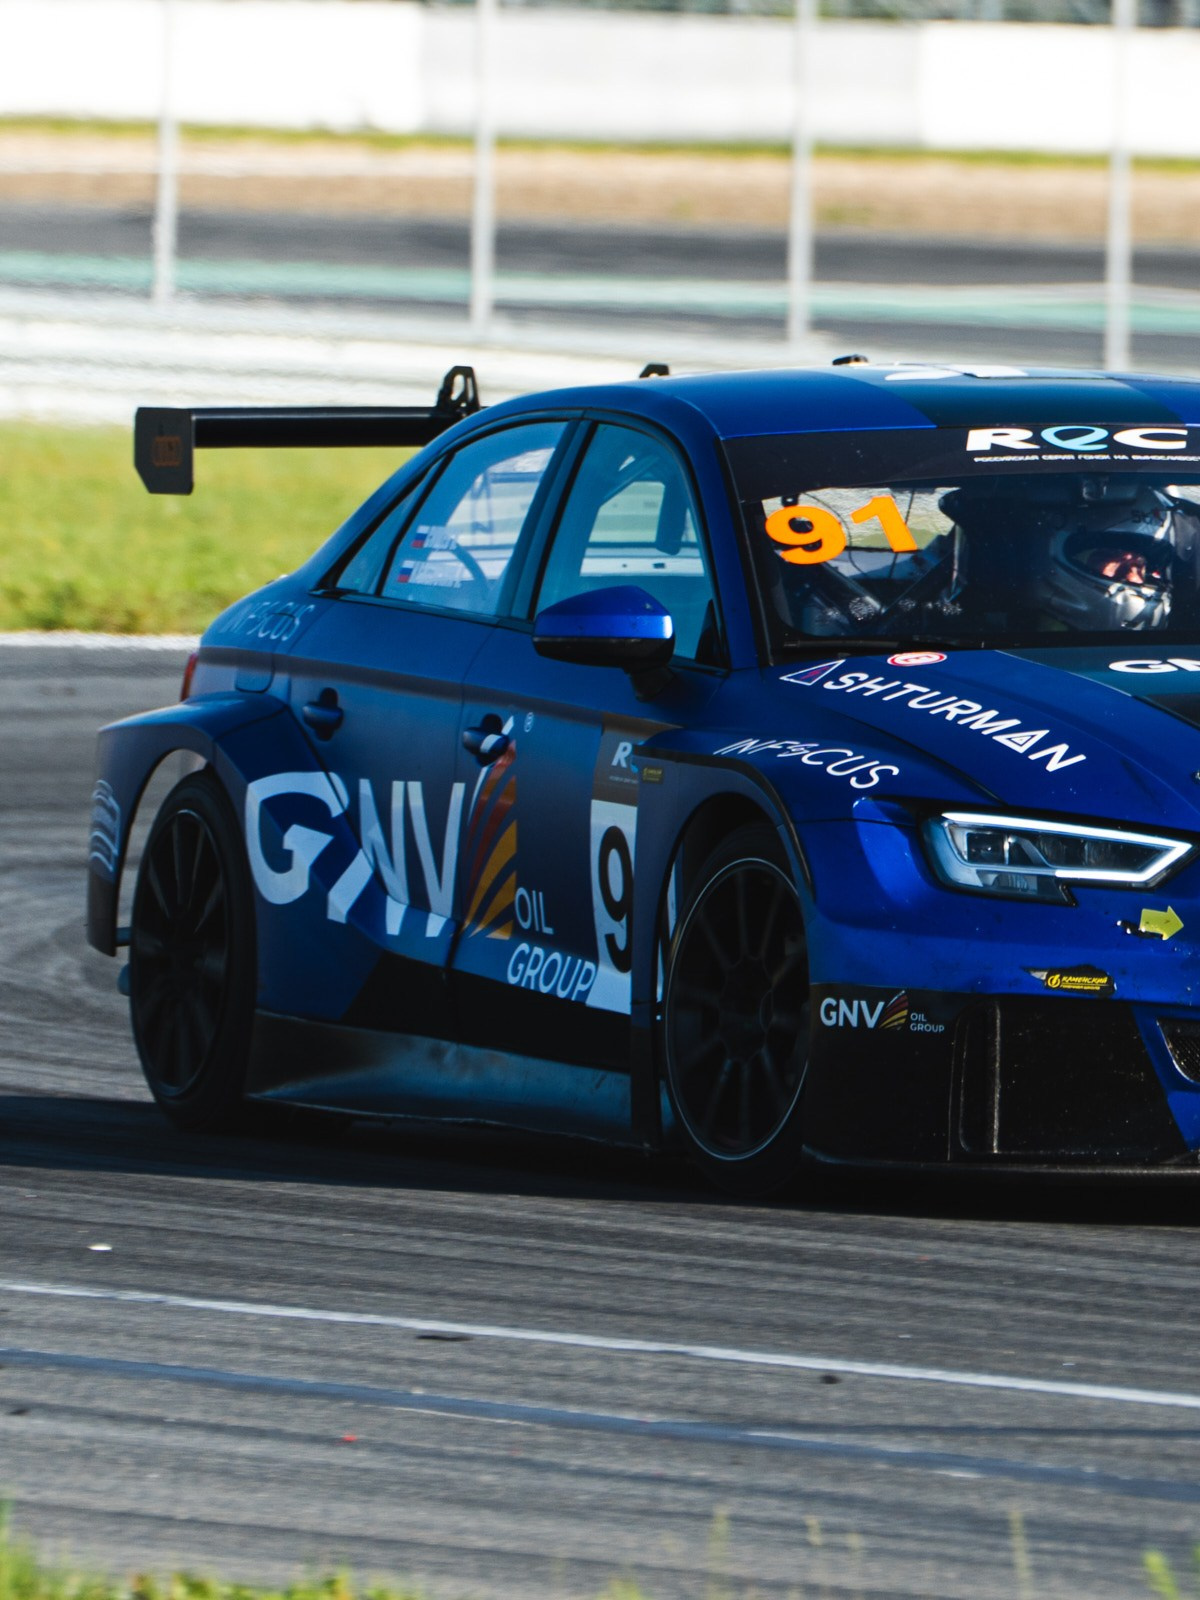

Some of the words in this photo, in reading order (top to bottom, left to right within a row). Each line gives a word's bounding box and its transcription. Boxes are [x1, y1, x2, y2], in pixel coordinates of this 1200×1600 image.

[765, 495, 918, 565] 91
[245, 771, 466, 937] GNV
[514, 887, 554, 936] OIL
[507, 942, 597, 1003] GROUP
[820, 997, 885, 1029] GNV
[910, 1012, 927, 1022] OIL
[910, 1022, 945, 1033] GROUP
